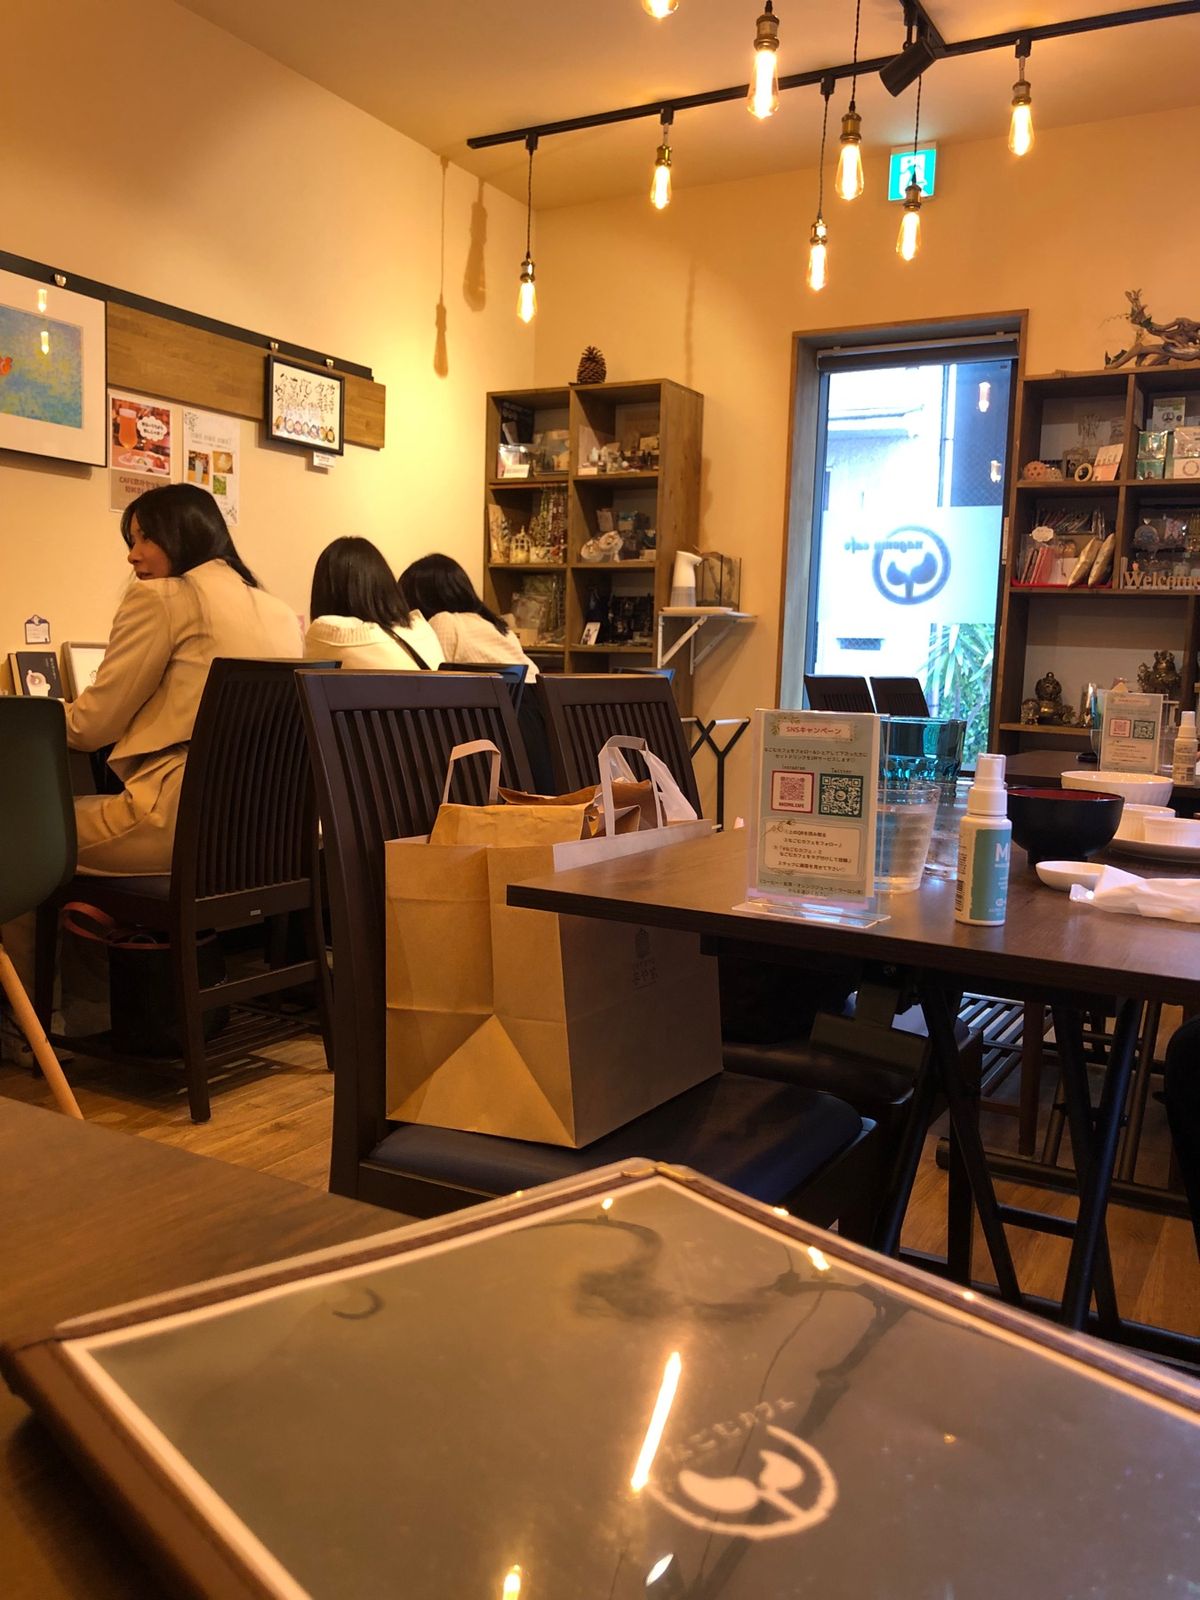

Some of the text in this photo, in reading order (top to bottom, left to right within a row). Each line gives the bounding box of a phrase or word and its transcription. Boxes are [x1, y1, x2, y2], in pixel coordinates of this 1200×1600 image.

[1124, 571, 1200, 588] Welcome
[786, 726, 841, 735] SNSキャンペーン
